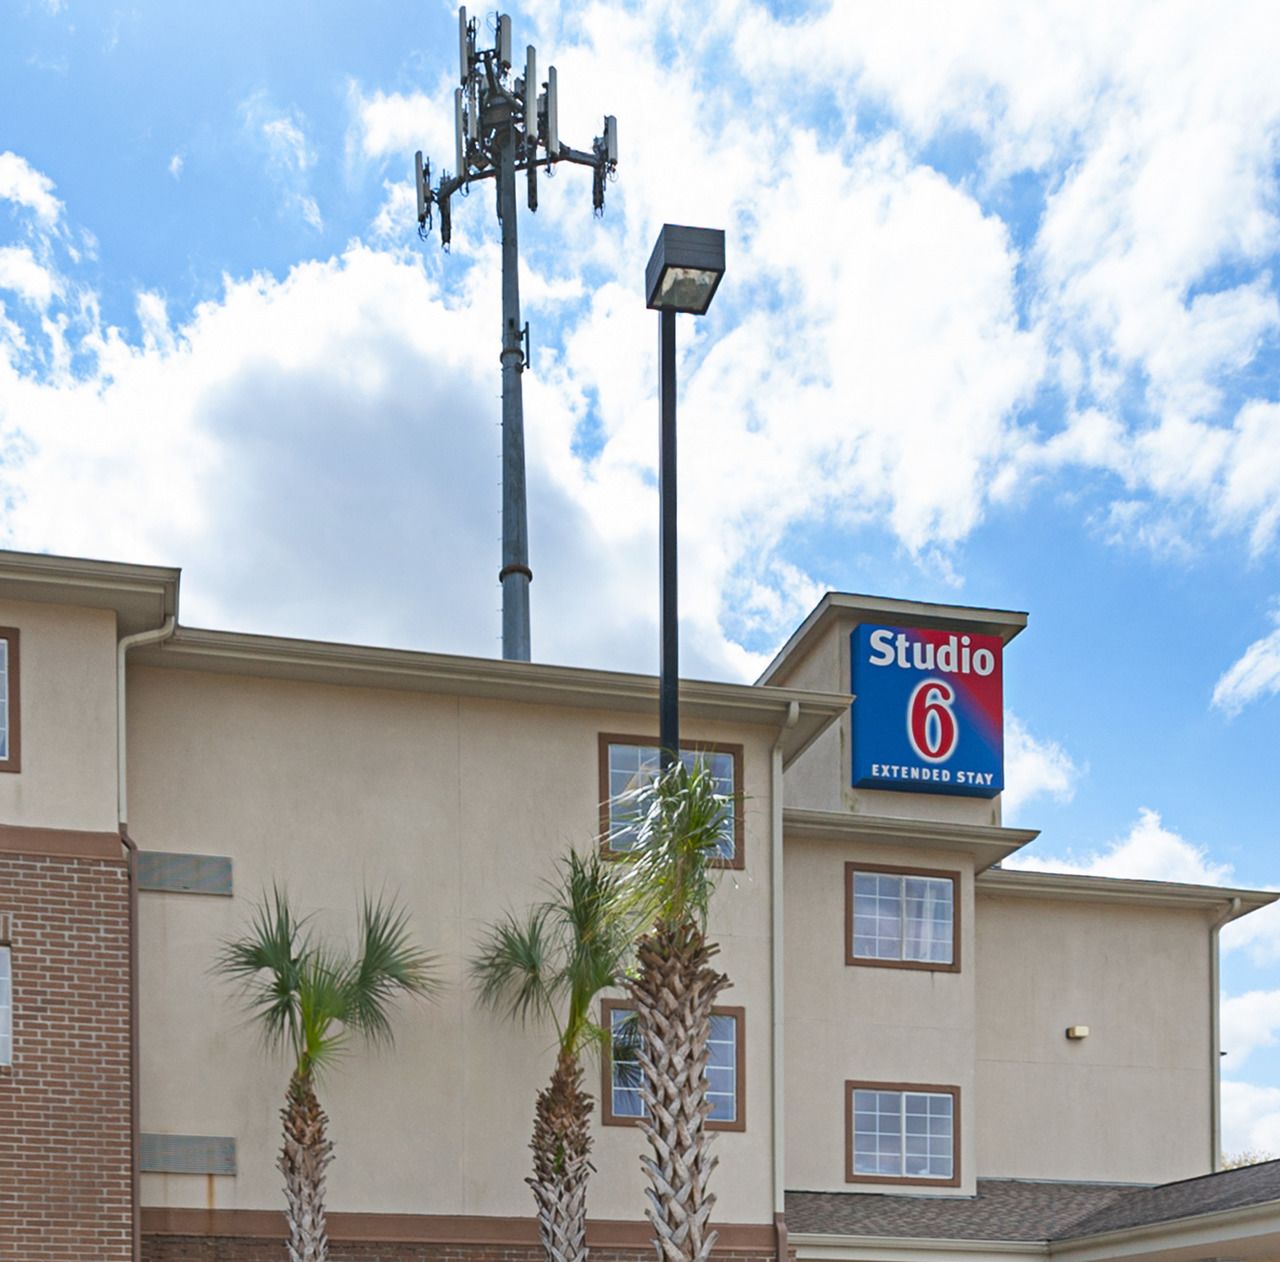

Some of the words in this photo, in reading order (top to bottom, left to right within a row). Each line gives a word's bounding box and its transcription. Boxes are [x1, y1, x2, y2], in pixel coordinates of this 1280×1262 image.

[869, 629, 995, 675] Studio
[907, 678, 958, 763] 6
[872, 764, 950, 781] EXTENDED
[957, 771, 993, 785] STAY
